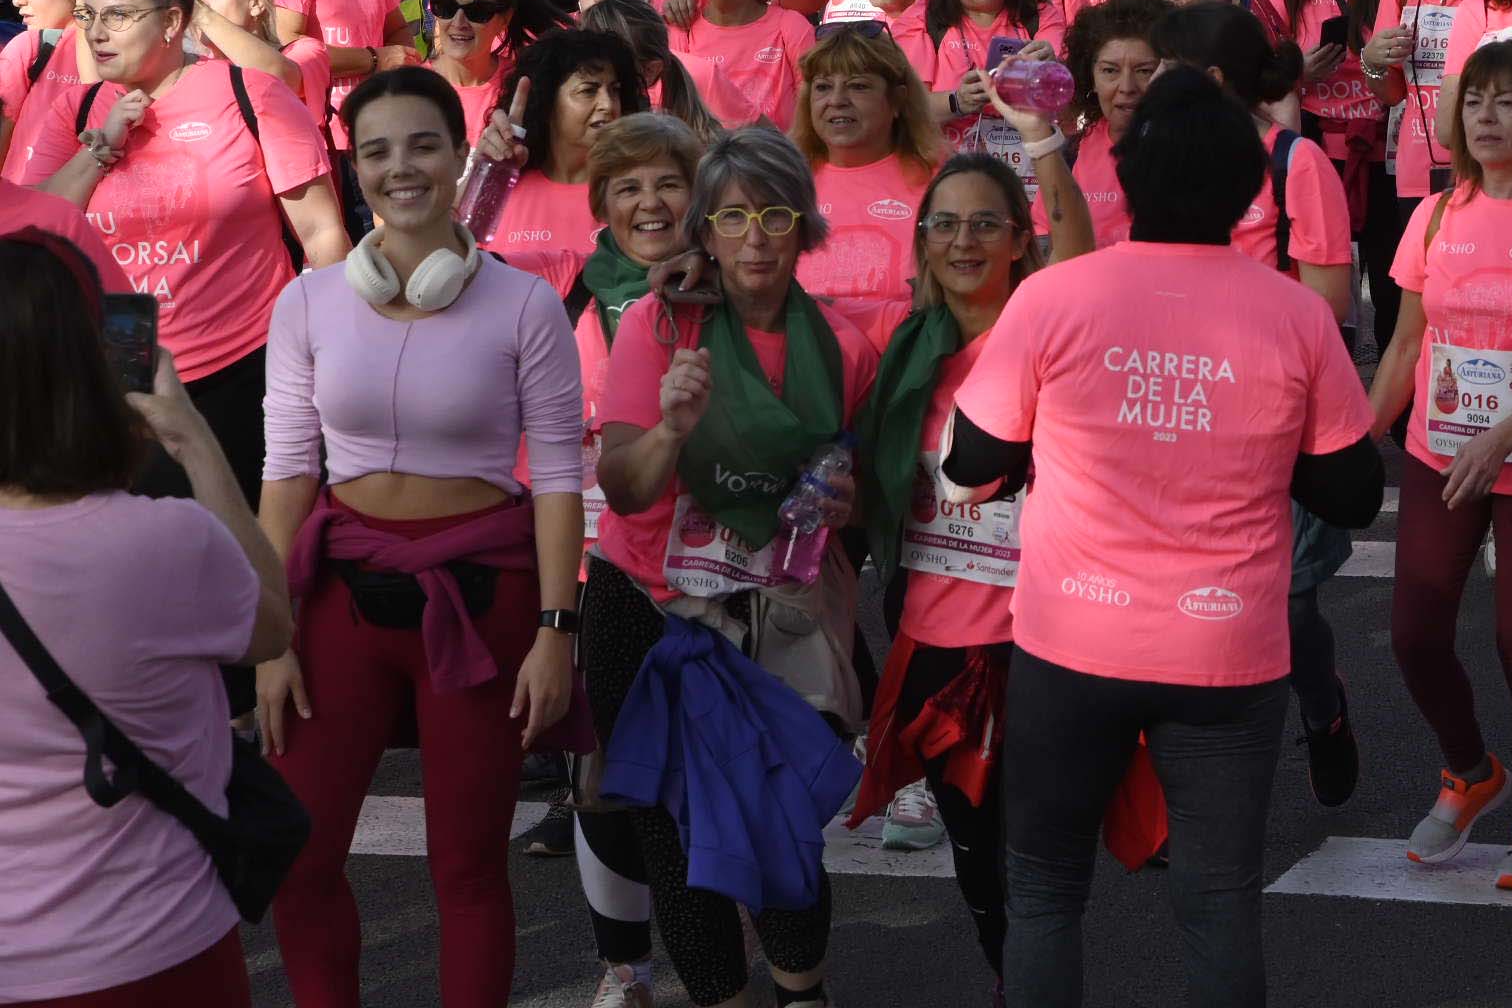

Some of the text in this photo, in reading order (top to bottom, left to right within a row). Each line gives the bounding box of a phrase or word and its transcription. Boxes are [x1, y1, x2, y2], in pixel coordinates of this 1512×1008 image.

[324, 26, 350, 45] TU
[1420, 37, 1449, 49] 016
[1422, 51, 1444, 60] 22379
[1083, 191, 1118, 203] YSHO
[508, 230, 552, 243] OYSHO
[127, 274, 173, 299] MA
[1103, 346, 1236, 384] CARRERA
[1459, 367, 1503, 380] ASTURIANA
[1126, 374, 1208, 405] DE LA
[1461, 392, 1499, 410] 016
[1116, 399, 1213, 433] MUJER
[1466, 412, 1491, 425] 9094
[1438, 423, 1468, 434] CARRERA
[1468, 426, 1477, 435] DE
[1153, 431, 1178, 443] 2023
[940, 499, 982, 522] 016
[948, 522, 974, 538] 6276
[914, 533, 948, 546] CARRERA
[948, 539, 959, 548] DE
[959, 541, 969, 549] LA
[969, 543, 993, 554] MUJER
[682, 559, 720, 572] CARRERA
[724, 549, 749, 567] 6206
[911, 551, 948, 566] OYSHO
[976, 562, 1015, 577] Santander
[675, 575, 720, 589] OYSHO
[1061, 577, 1131, 607] OYSHO
[1181, 596, 1239, 613] ASTURIANA
